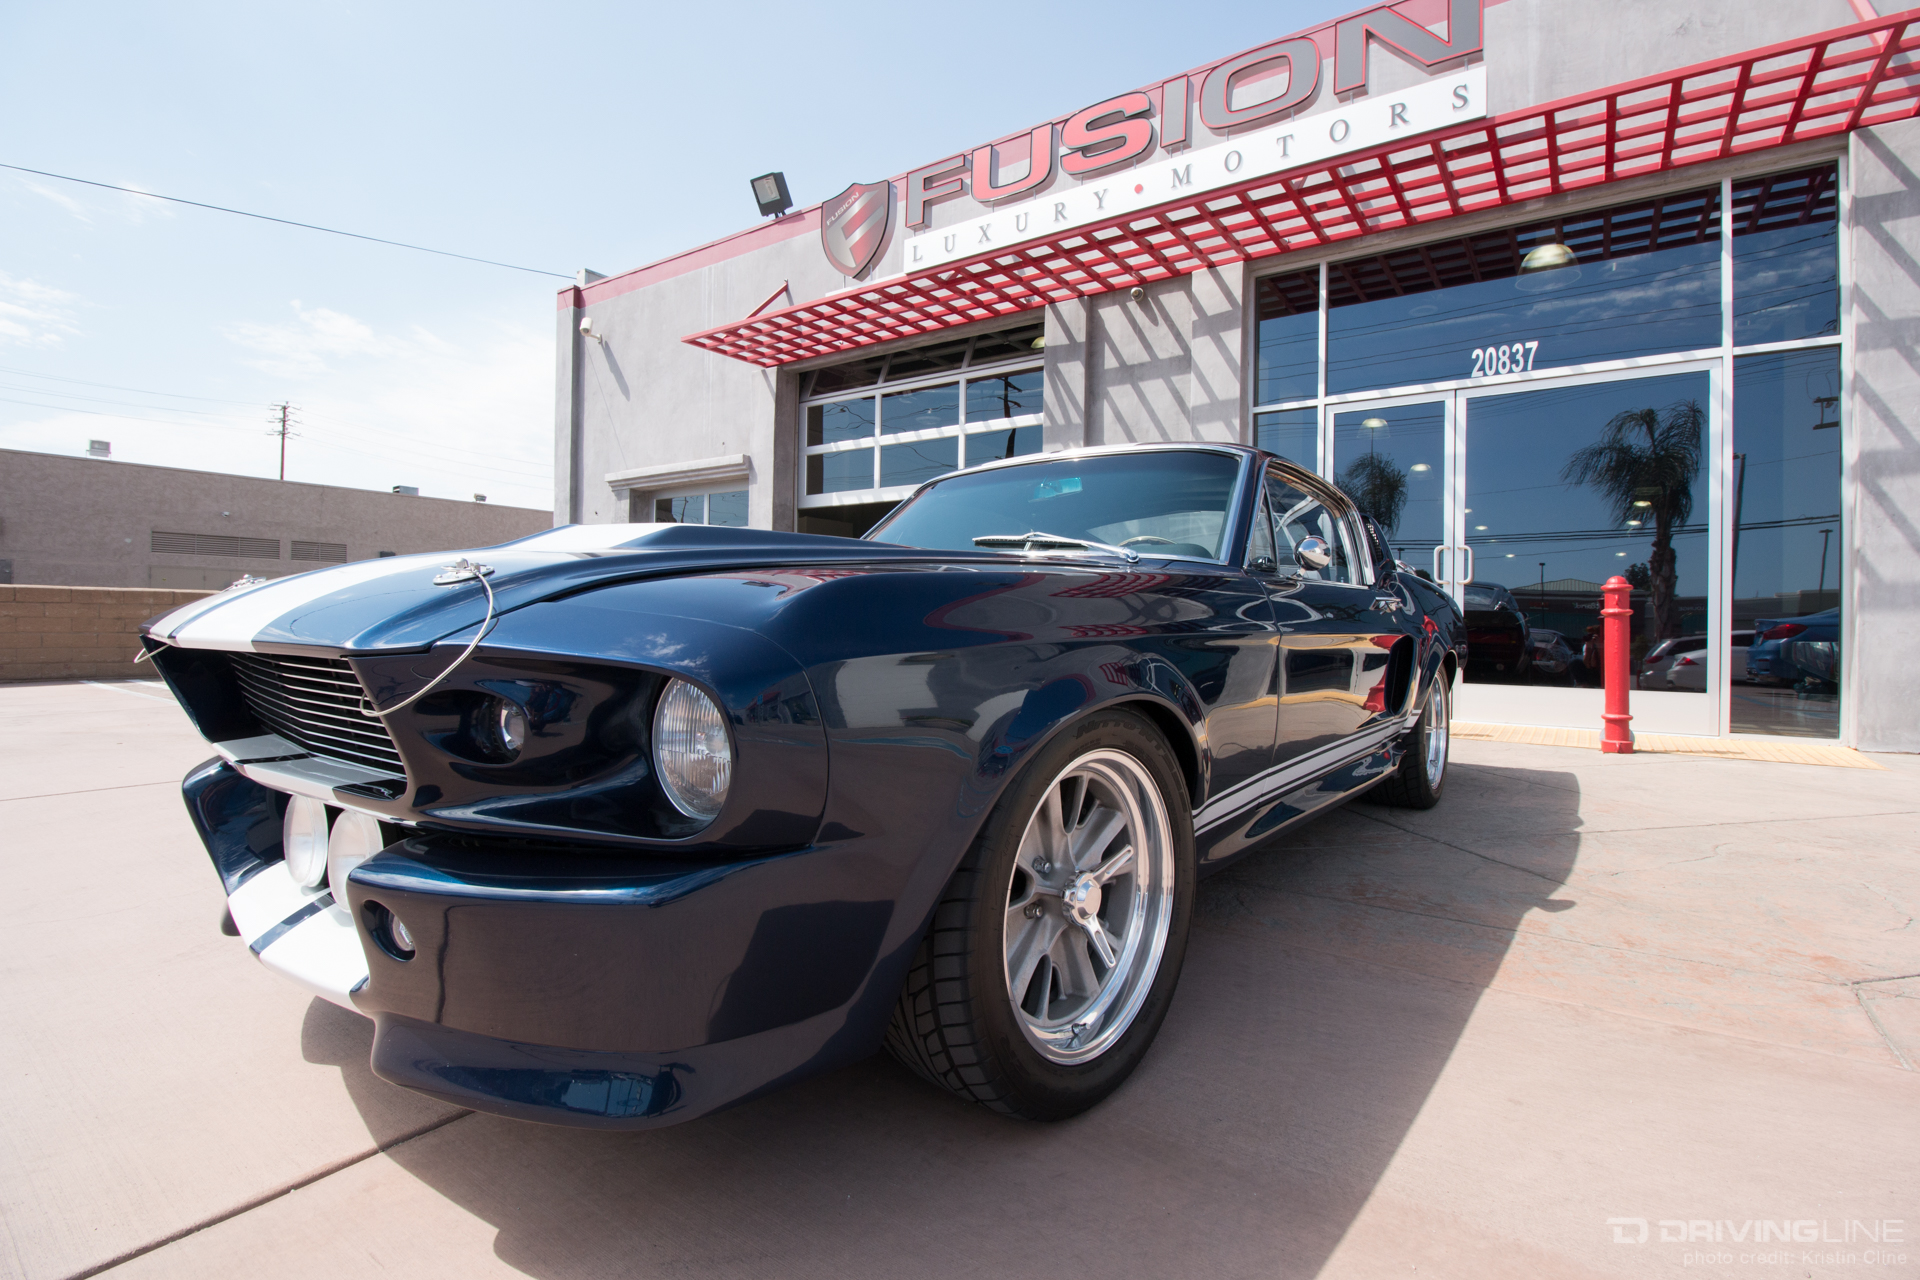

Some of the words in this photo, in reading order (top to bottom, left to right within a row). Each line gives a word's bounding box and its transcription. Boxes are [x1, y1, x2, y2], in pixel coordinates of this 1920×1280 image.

[904, 0, 1484, 228] FUSION
[826, 191, 860, 227] FUSION
[911, 187, 1109, 263] LUXURY
[1170, 83, 1469, 190] MOTORS
[1470, 340, 1539, 378] 20837
